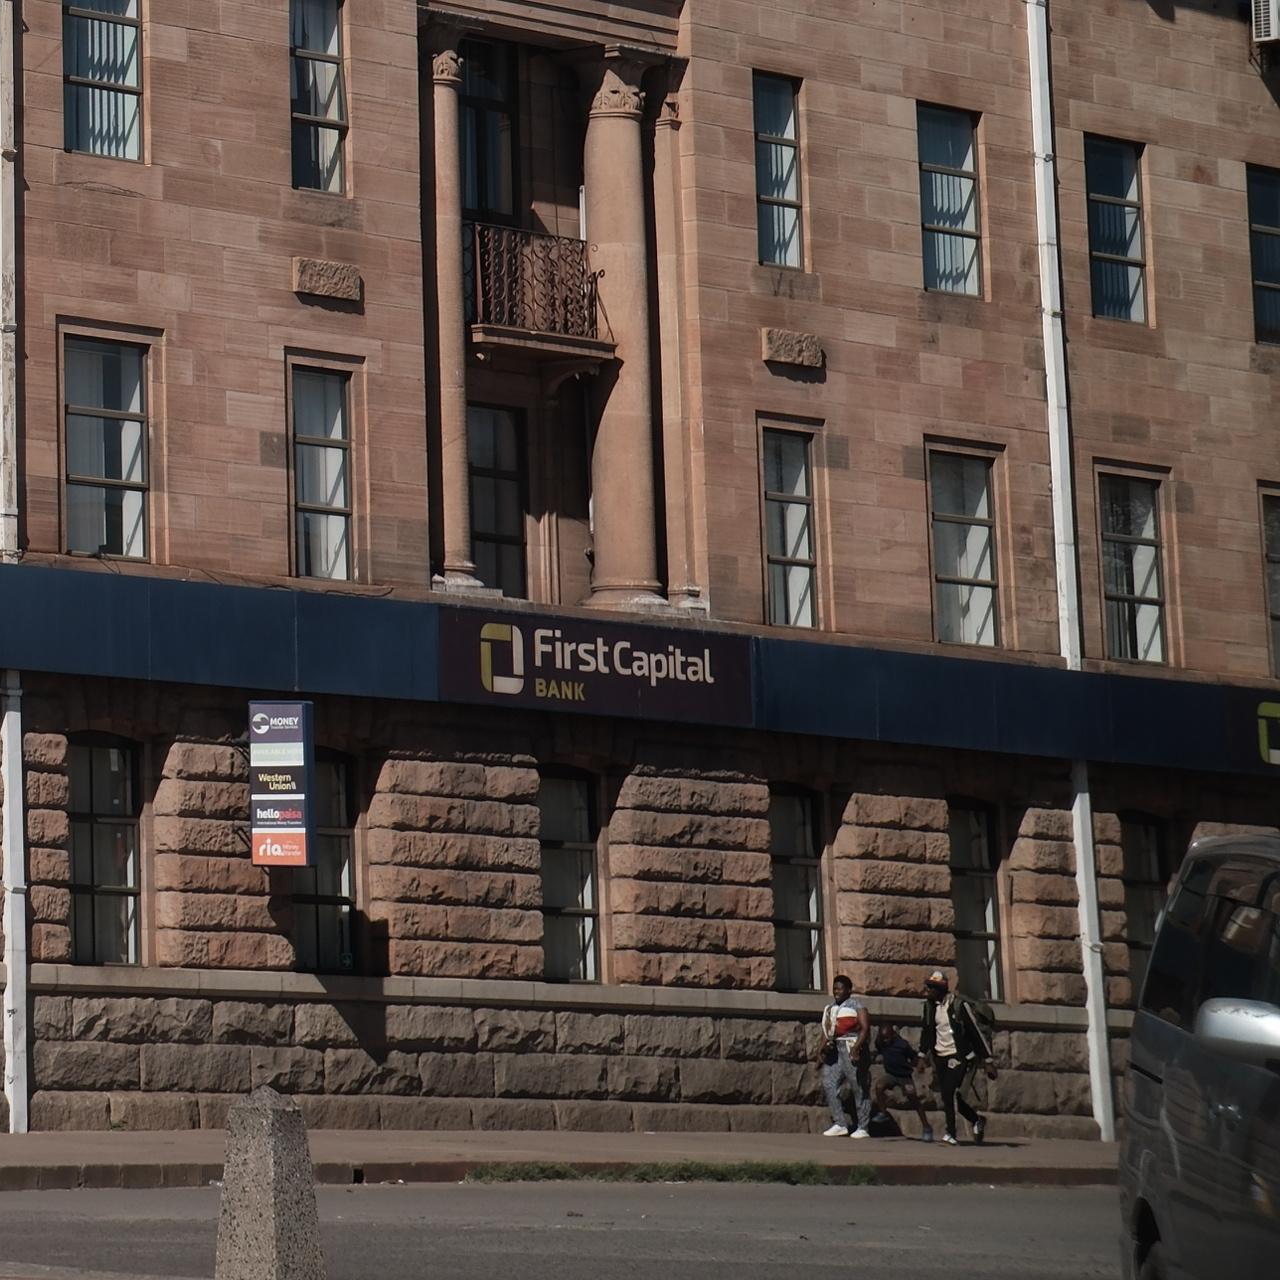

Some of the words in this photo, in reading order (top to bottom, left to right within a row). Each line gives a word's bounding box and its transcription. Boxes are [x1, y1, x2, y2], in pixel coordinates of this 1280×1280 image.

[534, 628, 610, 674] First
[613, 641, 715, 687] Capital
[535, 678, 586, 702] BANK
[270, 716, 299, 726] MONEY
[258, 773, 292, 782] Western
[269, 781, 291, 790] Union
[259, 838, 284, 857] ria
